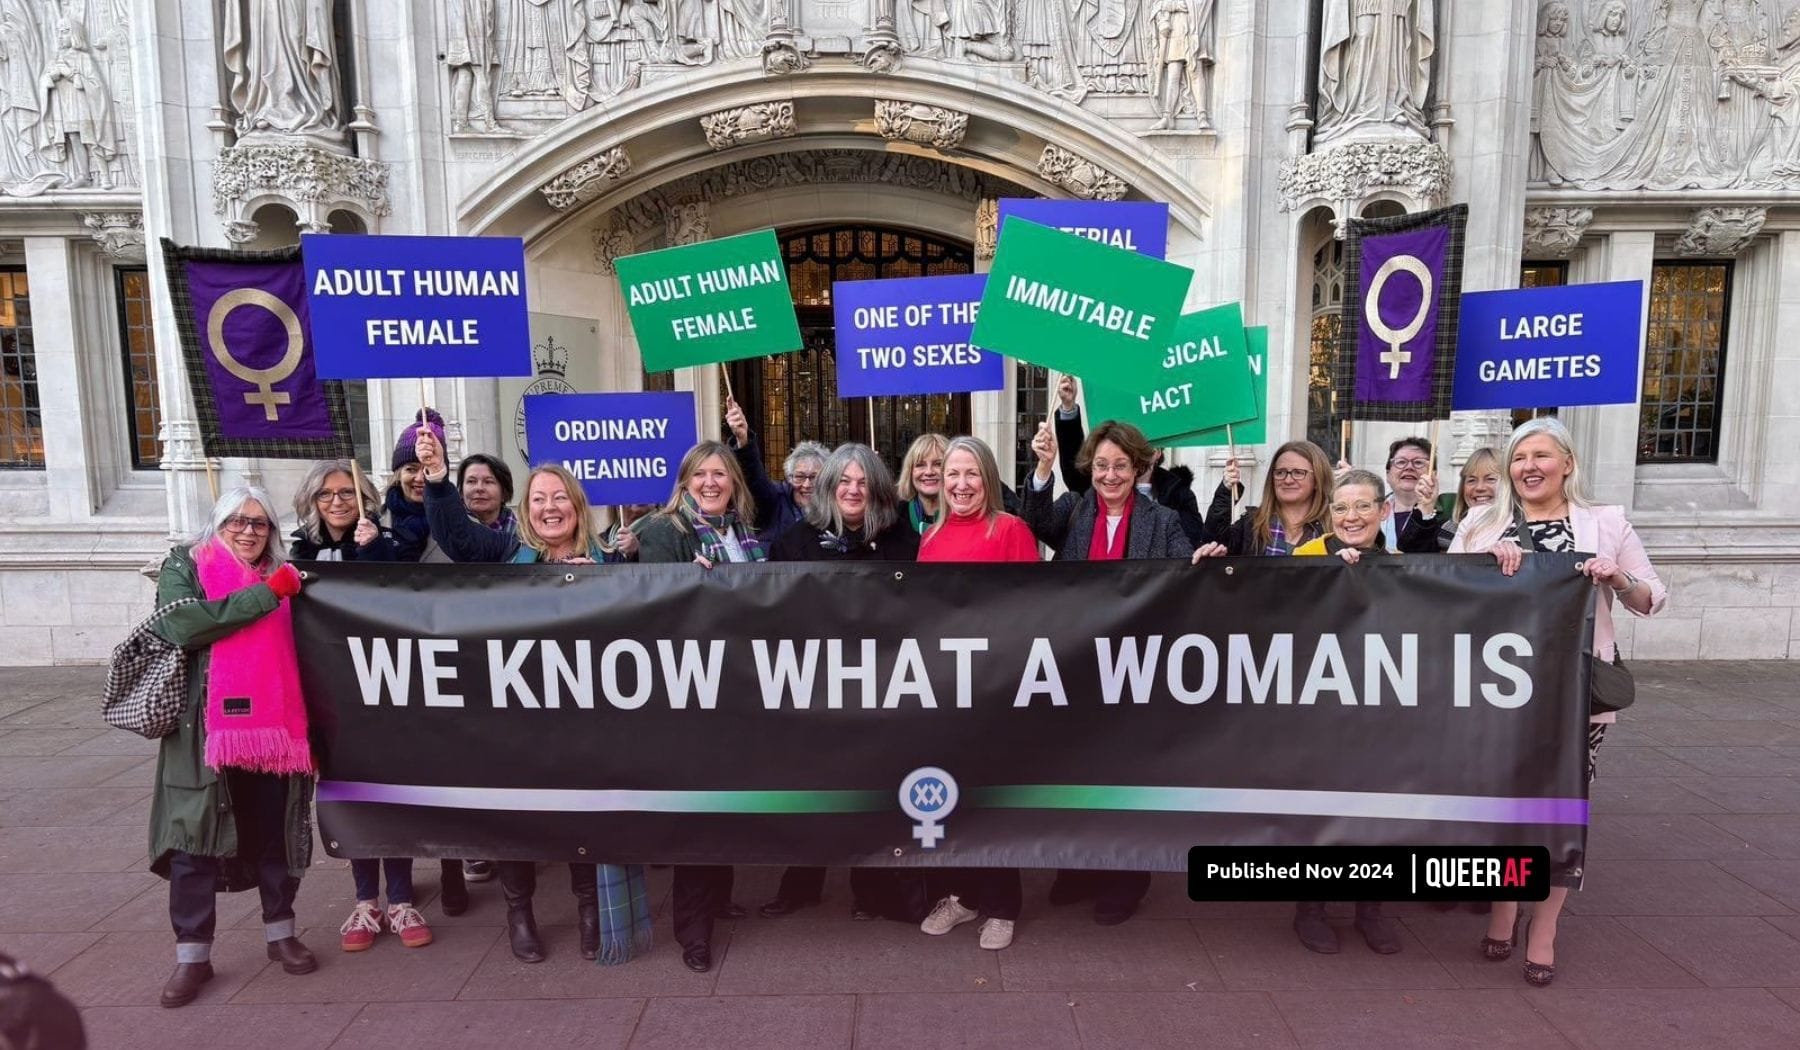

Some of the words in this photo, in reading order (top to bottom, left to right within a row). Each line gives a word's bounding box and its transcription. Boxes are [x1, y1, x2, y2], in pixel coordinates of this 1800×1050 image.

[313, 269, 406, 296] ADULT
[413, 269, 520, 296] HUMAN
[629, 275, 692, 306] ADULT
[697, 260, 780, 295] HUMAN
[854, 306, 899, 330] ONE
[904, 304, 933, 327] OF
[938, 301, 981, 325] THE
[1006, 276, 1155, 340] IMMUTABLE
[366, 319, 479, 346] FEMALE
[671, 307, 757, 341] FEMALE
[1500, 313, 1584, 341] LARGE
[856, 346, 906, 370] TWO
[912, 343, 982, 367] SEXES
[1162, 336, 1228, 369] GICAL
[1479, 354, 1601, 383] GAMETES
[554, 418, 669, 442] ORDINARY
[562, 457, 667, 480] MEANING
[347, 636, 464, 708] WE
[486, 638, 727, 711] KNOW
[751, 637, 989, 711] WHAT
[1013, 637, 1068, 707] A
[1094, 633, 1419, 707] WOMAN
[1453, 632, 1534, 710] IS
[914, 782, 944, 807] XX
